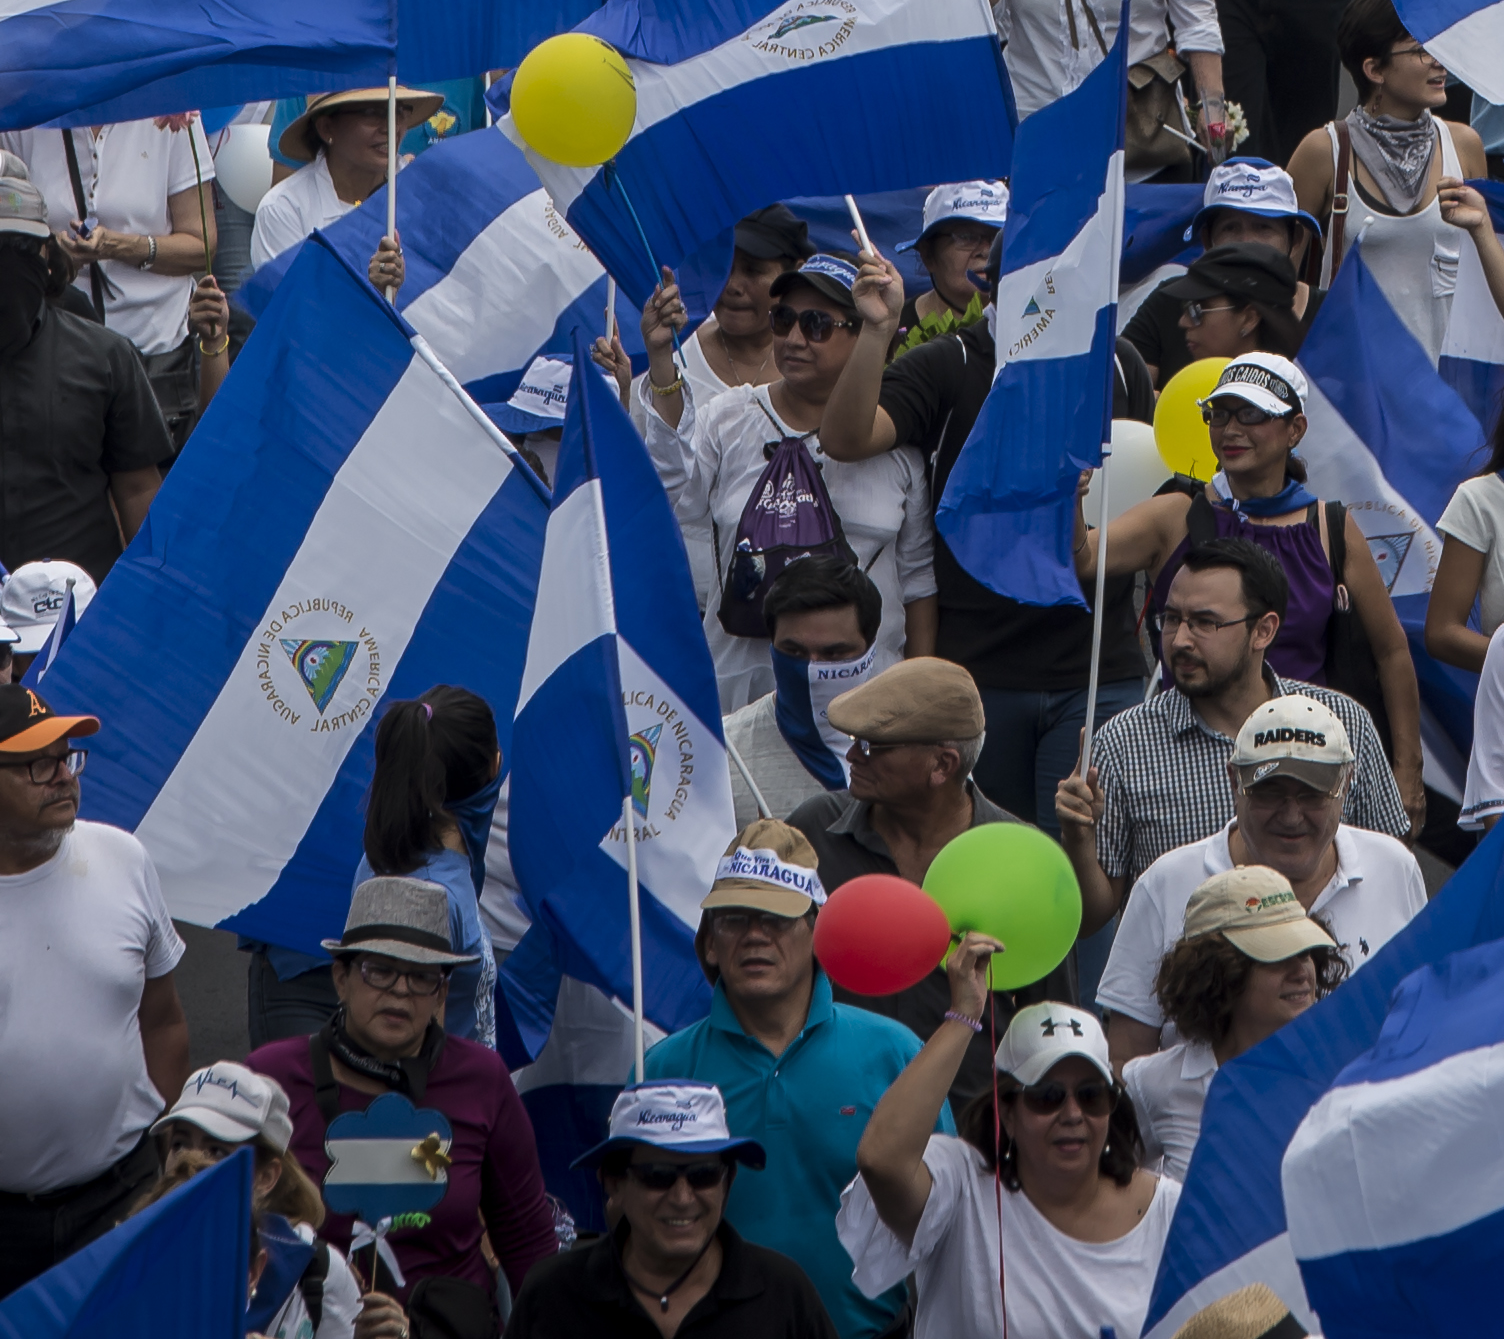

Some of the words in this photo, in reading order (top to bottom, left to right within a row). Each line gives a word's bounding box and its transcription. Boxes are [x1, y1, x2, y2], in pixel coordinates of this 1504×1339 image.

[1218, 182, 1268, 199] Nicaragua
[26, 688, 46, 718] A
[656, 701, 679, 724] DE
[1253, 726, 1328, 749] RAIDERS
[663, 720, 695, 822] NICARAGUA
[734, 850, 752, 863] Que
[729, 860, 815, 895] NICARAGUA
[637, 1109, 698, 1132] Nicaragua
